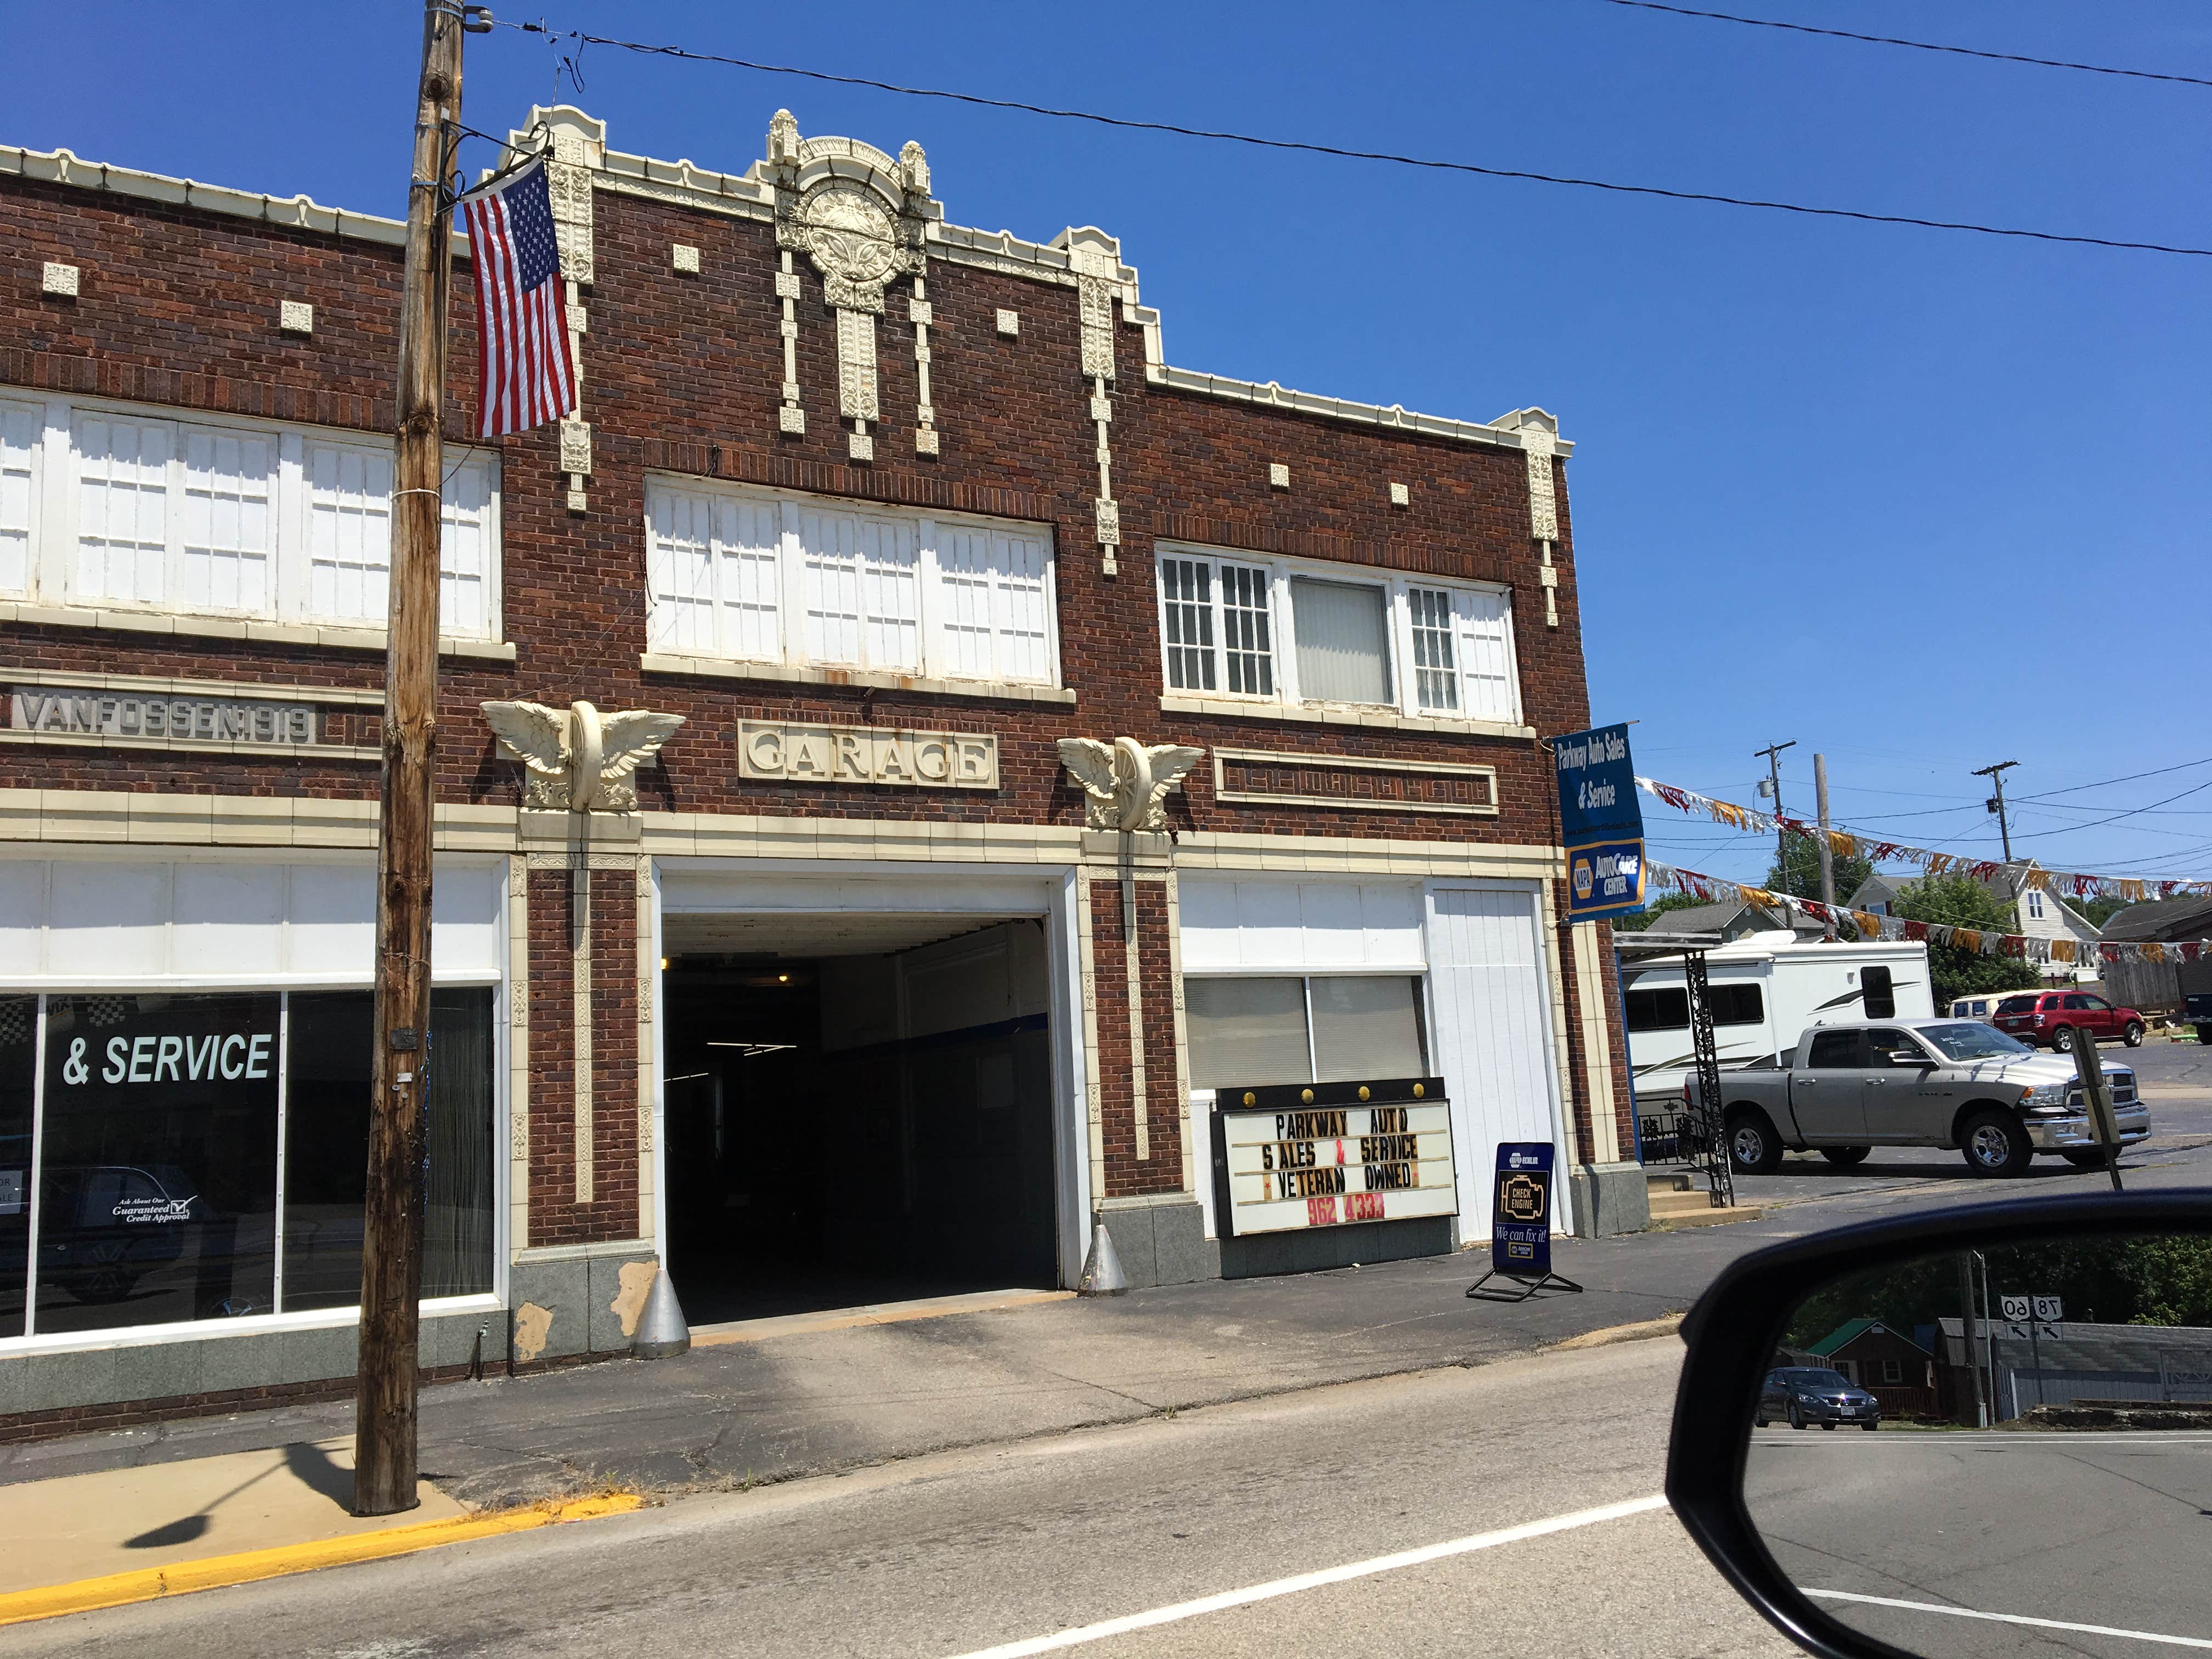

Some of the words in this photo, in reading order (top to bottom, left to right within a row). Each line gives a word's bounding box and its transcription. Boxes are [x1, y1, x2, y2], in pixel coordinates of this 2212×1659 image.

[747, 729, 991, 781] GARAGE
[1558, 740, 1587, 771] Parkway
[1588, 736, 1604, 765] Auto
[1605, 732, 1626, 762] Sales
[1578, 781, 1586, 810] &
[1587, 778, 1616, 809] Service
[1575, 868, 1591, 889] NAPA
[1604, 876, 1628, 896] CENTER
[63, 1037, 89, 1085] &
[102, 1034, 272, 1084] SERVICE
[1276, 1110, 1347, 1140] PARKWAY
[1372, 1108, 1408, 1134] AUTO
[1263, 1141, 1316, 1170] SALES
[1336, 1138, 1345, 1164] &
[1361, 1134, 1418, 1162] SERVICE
[1278, 1167, 1345, 1198] VETERAN
[1365, 1163, 1410, 1190] OWNED
[1513, 1188, 1531, 1199] CHECK
[112, 1204, 170, 1215] Guaranteed
[126, 1214, 151, 1222] Credit
[152, 1212, 190, 1223] Approval
[1308, 1197, 1336, 1225] 962
[1345, 1193, 1385, 1221] 4333
[1511, 1199, 1533, 1209] ENGINE
[1496, 1226, 1508, 1240] We
[1510, 1231, 1523, 1242] can
[1526, 1228, 1536, 1243] fix
[1538, 1229, 1547, 1243] it!
